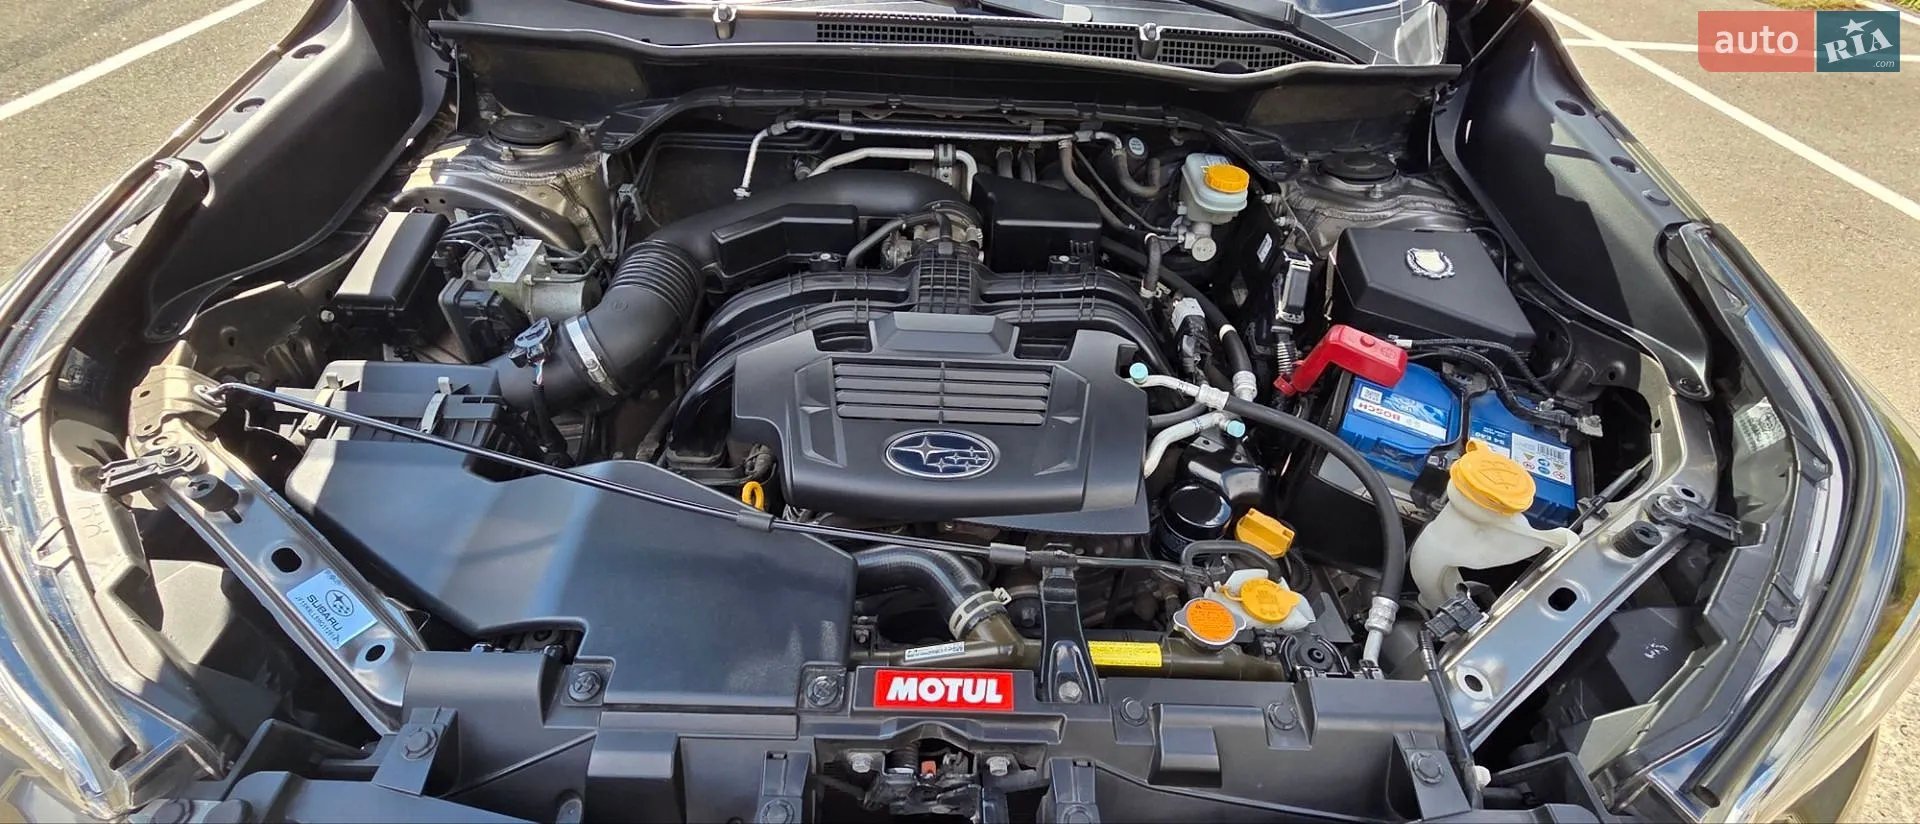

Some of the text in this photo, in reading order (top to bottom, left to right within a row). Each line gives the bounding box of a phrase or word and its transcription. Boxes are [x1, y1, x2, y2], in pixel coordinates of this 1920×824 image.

[1358, 402, 1401, 421] BOSCH
[306, 593, 343, 631] SUBARU
[886, 676, 1003, 704] MOTUL
